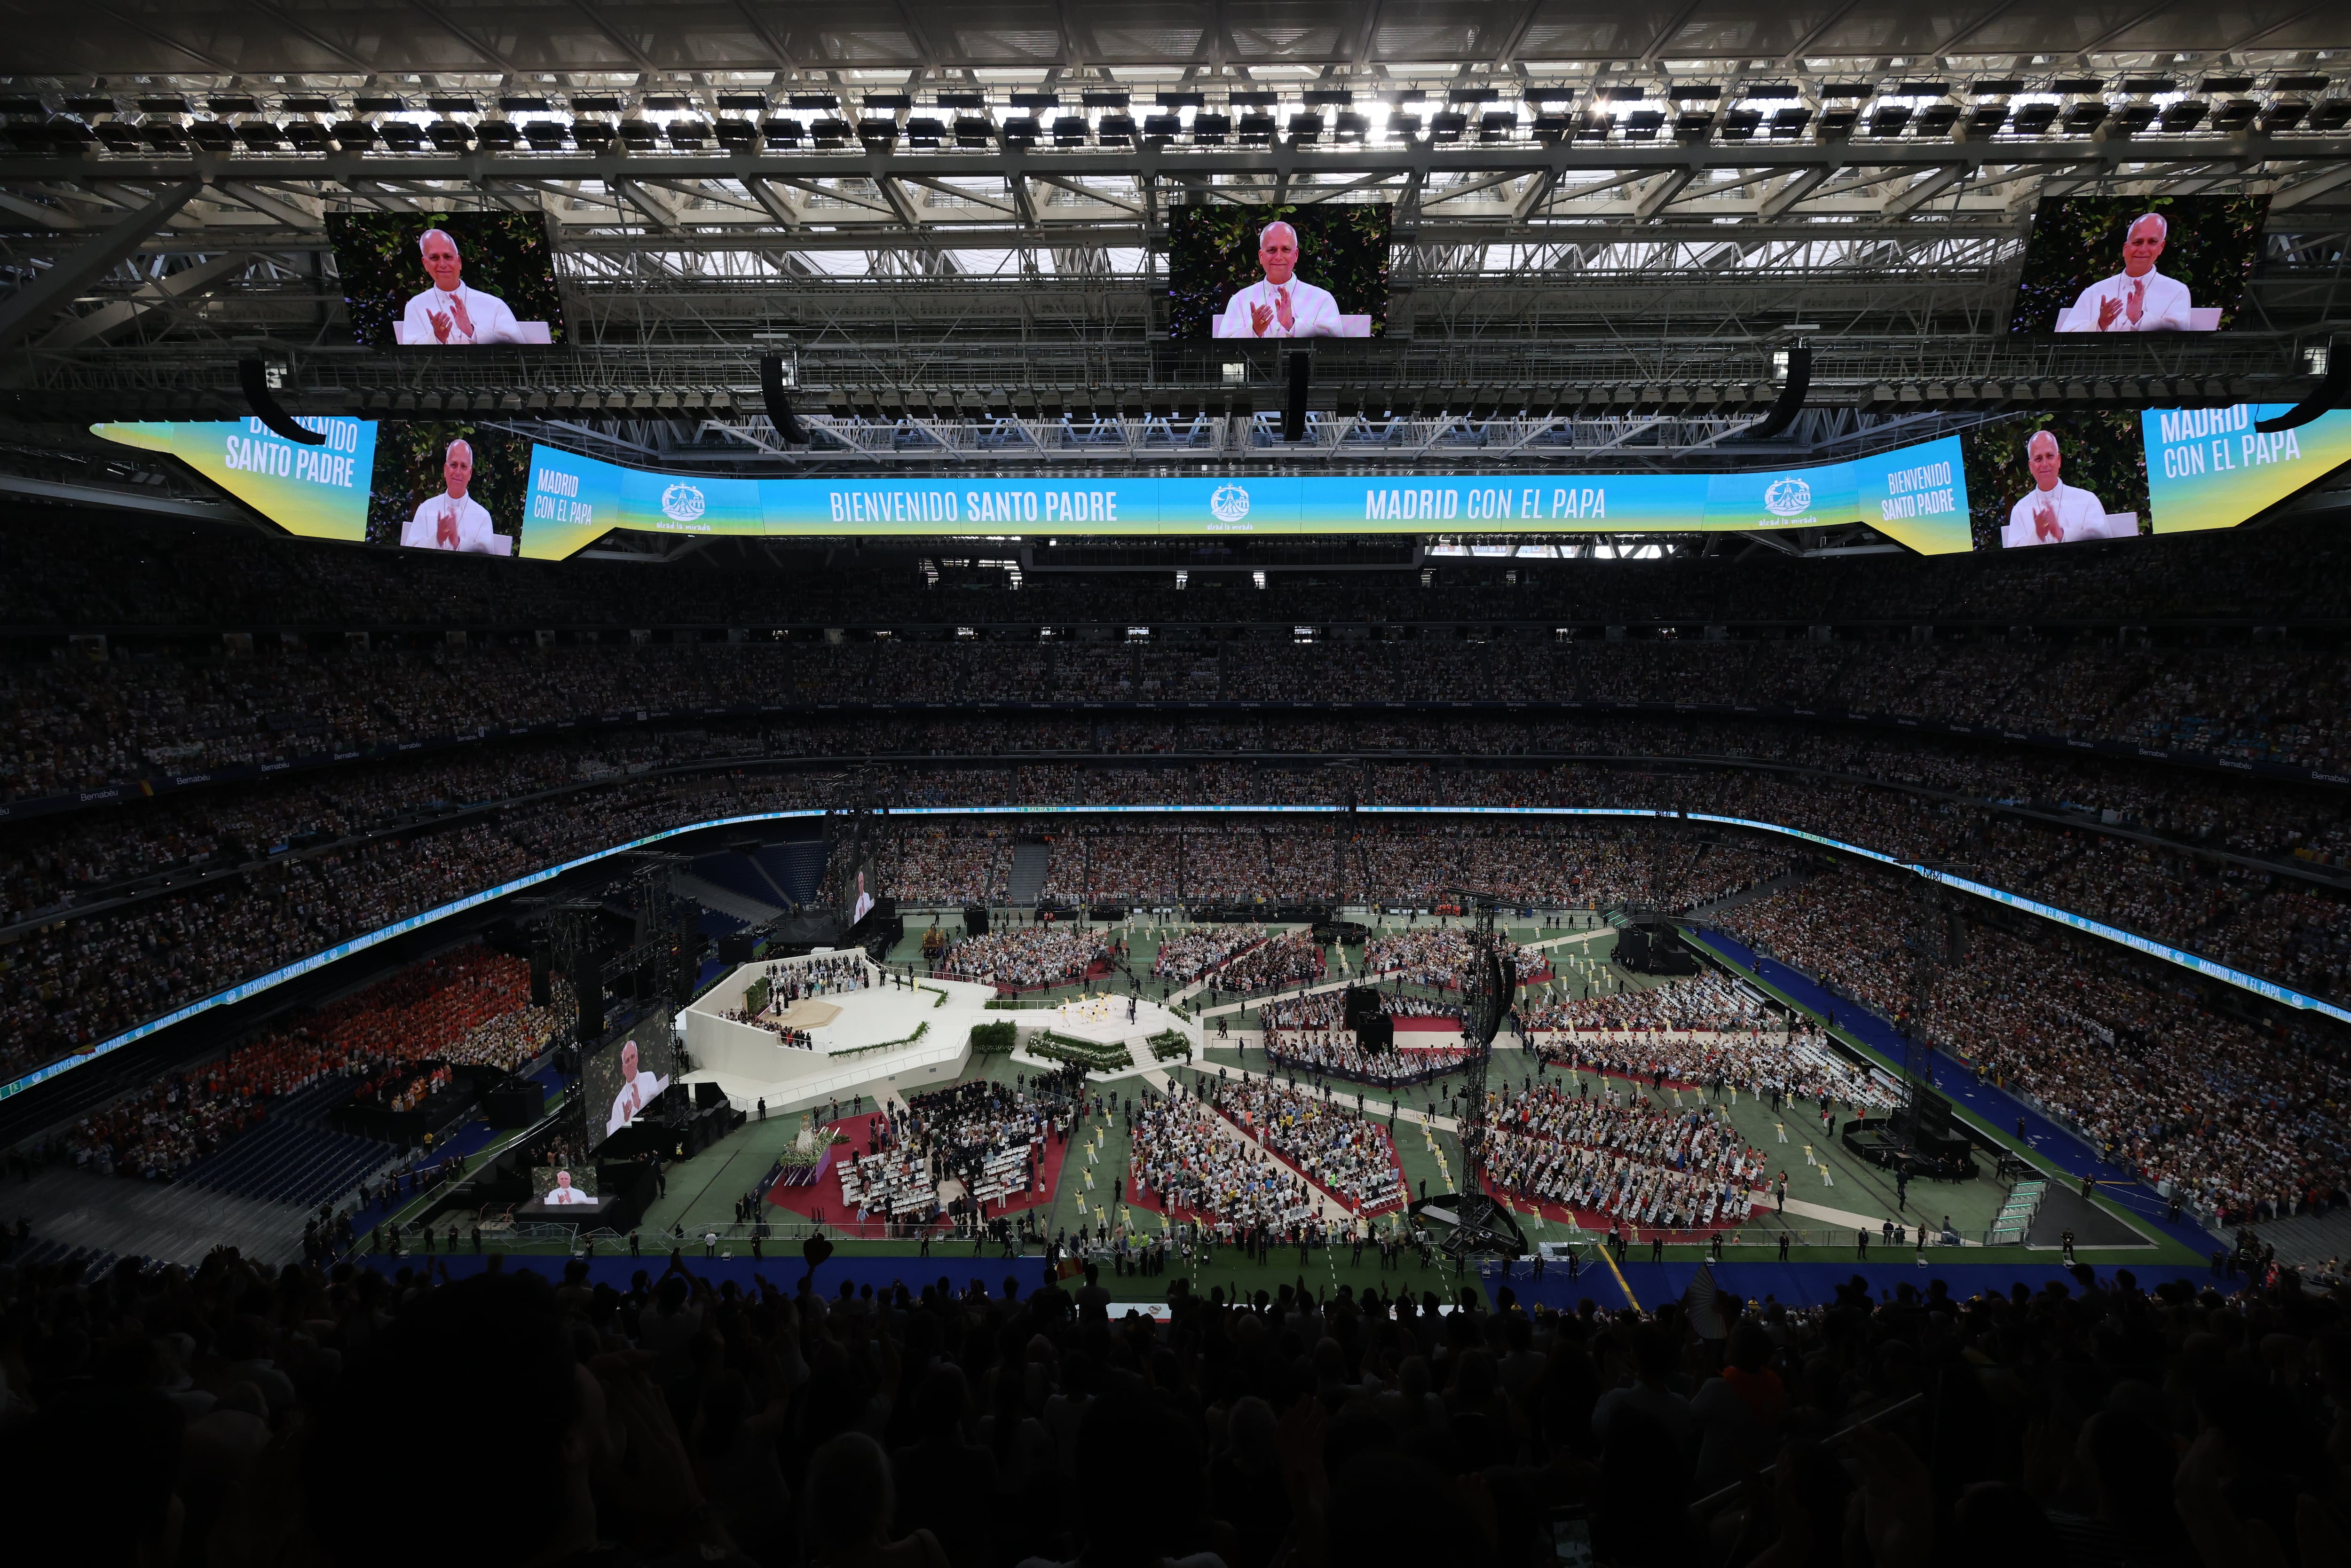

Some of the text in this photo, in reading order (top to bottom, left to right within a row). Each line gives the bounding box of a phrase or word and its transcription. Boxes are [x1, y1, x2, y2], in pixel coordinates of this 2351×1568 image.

[2161, 404, 2248, 444] MADRID
[225, 435, 355, 488] SANTO PADRE
[2164, 429, 2301, 478] CON EL PAPA
[537, 468, 579, 498] MADRID
[1888, 461, 1951, 495] BIENVENIDO
[534, 495, 592, 526] CON EL PAPA
[830, 491, 1117, 521] BIENVENIDO SANTO PADRE
[1365, 489, 1605, 520] MADRID CON EL PAPA
[1881, 489, 1955, 520] SANTO PADRE
[1759, 517, 1779, 526] alzad
[1791, 515, 1816, 524] mirada
[334, 751, 359, 760] Bernabéu
[2067, 739, 2093, 748] Bernabéu
[2139, 749, 2167, 757] Bernabéu
[177, 774, 210, 784] Bernabéu
[261, 761, 289, 771] Bernabéu
[2219, 759, 2252, 769] Bernabéu
[2312, 772, 2349, 783] Bernabéu
[81, 789, 118, 801] Bernabéu
[502, 871, 545, 894] MADRID CON EL PAPA
[1959, 880, 1974, 891] SANTO
[1975, 884, 1992, 897] PADRE
[425, 893, 485, 923] BIENVENIDO SANTO PADRE
[2012, 897, 2069, 923] MADRID CON EL PAPA
[348, 922, 407, 953] MADRID CON EL PAPA
[2090, 922, 2171, 959] BIENVENIDO SANTO PADRE
[242, 954, 325, 997] BIENVENIDO SANTO PADRE
[2199, 960, 2280, 1000] MADRID CON EL PAPA
[154, 1014, 178, 1030] MADRID
[179, 1008, 189, 1020] CON
[198, 1000, 212, 1011] PAPA
[47, 1035, 128, 1077] BIENVENIDO SANTO PADRE
